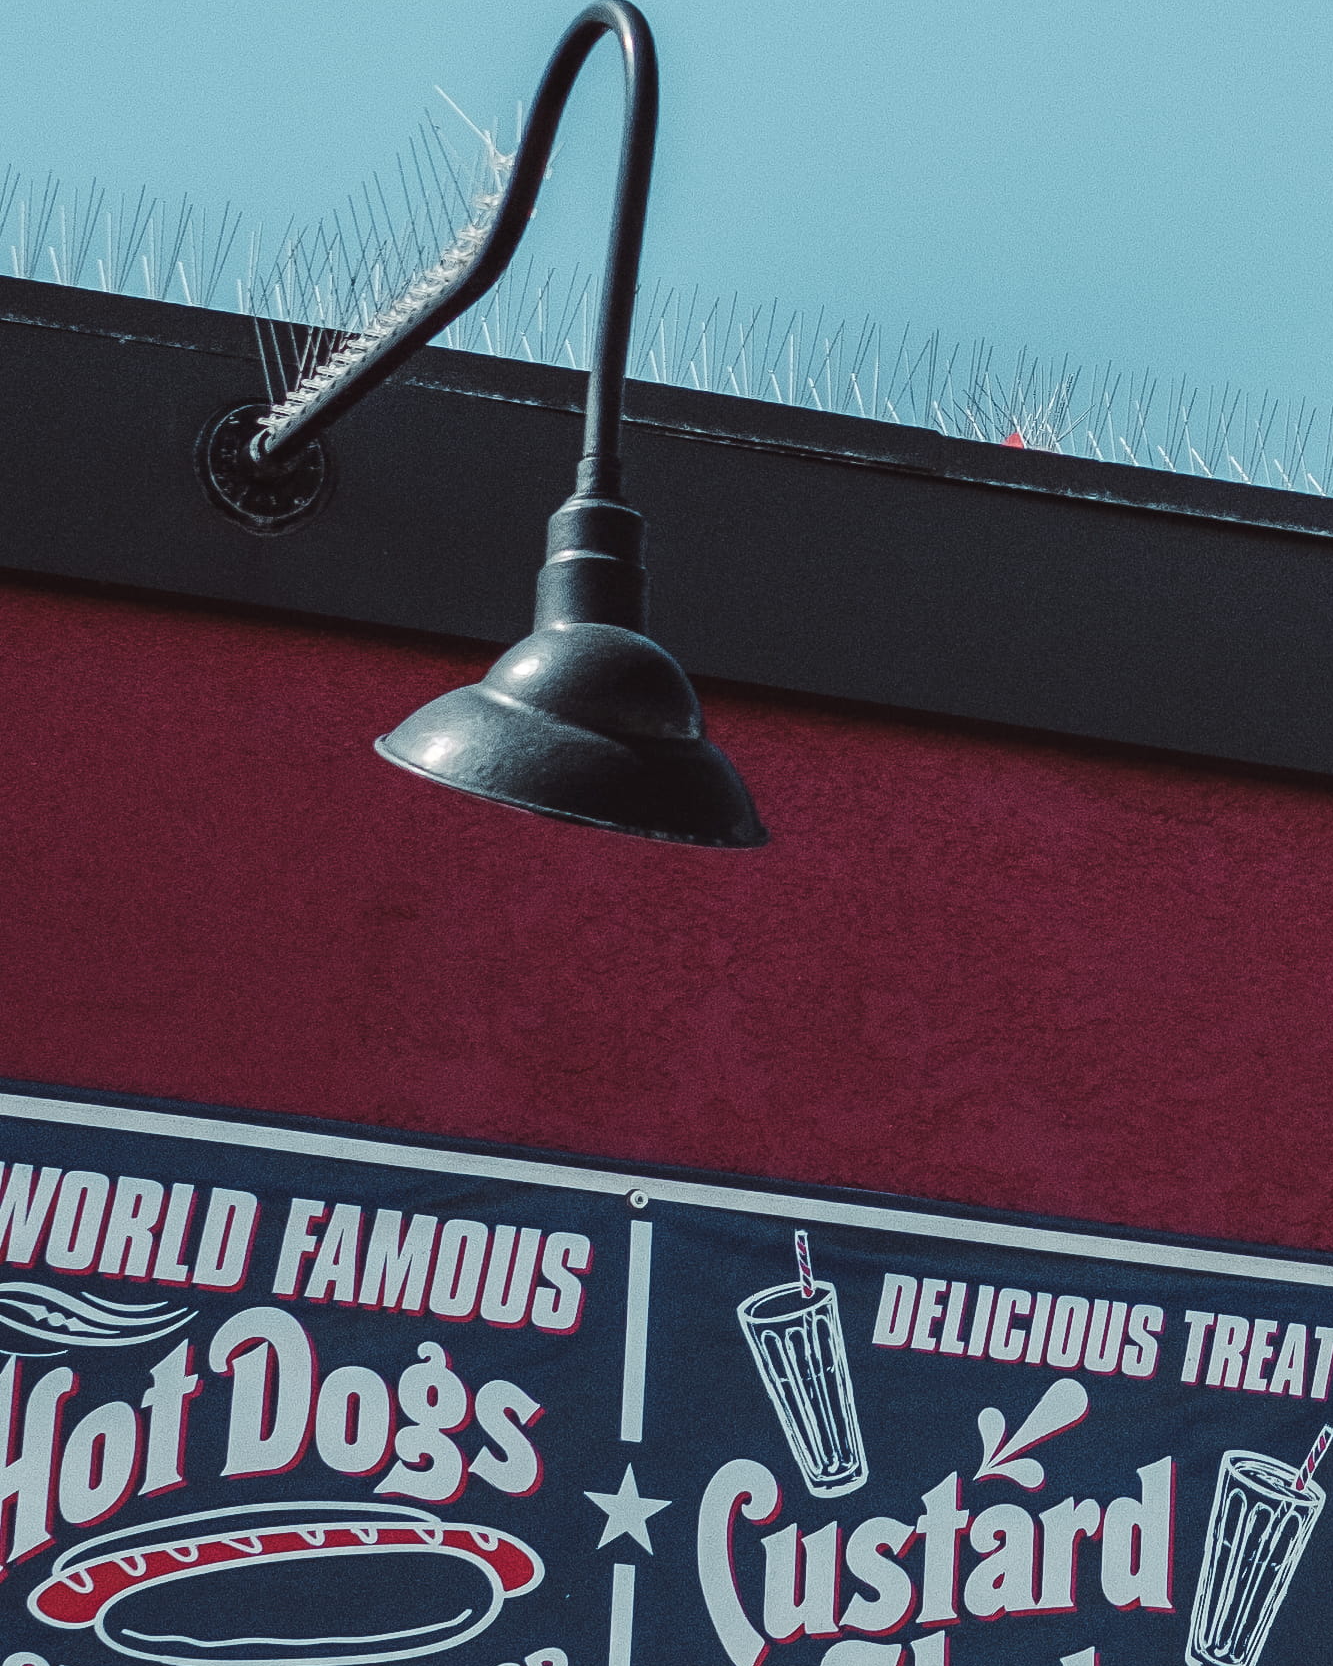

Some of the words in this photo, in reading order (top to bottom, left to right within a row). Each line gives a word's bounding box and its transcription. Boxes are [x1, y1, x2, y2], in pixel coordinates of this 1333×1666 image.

[0, 1161, 258, 1290] WORLD
[272, 1198, 592, 1332] FAMOUS
[872, 1273, 1164, 1378] DELICIOUS
[0, 1338, 199, 1569] Hot
[209, 1306, 543, 1502] Dogs
